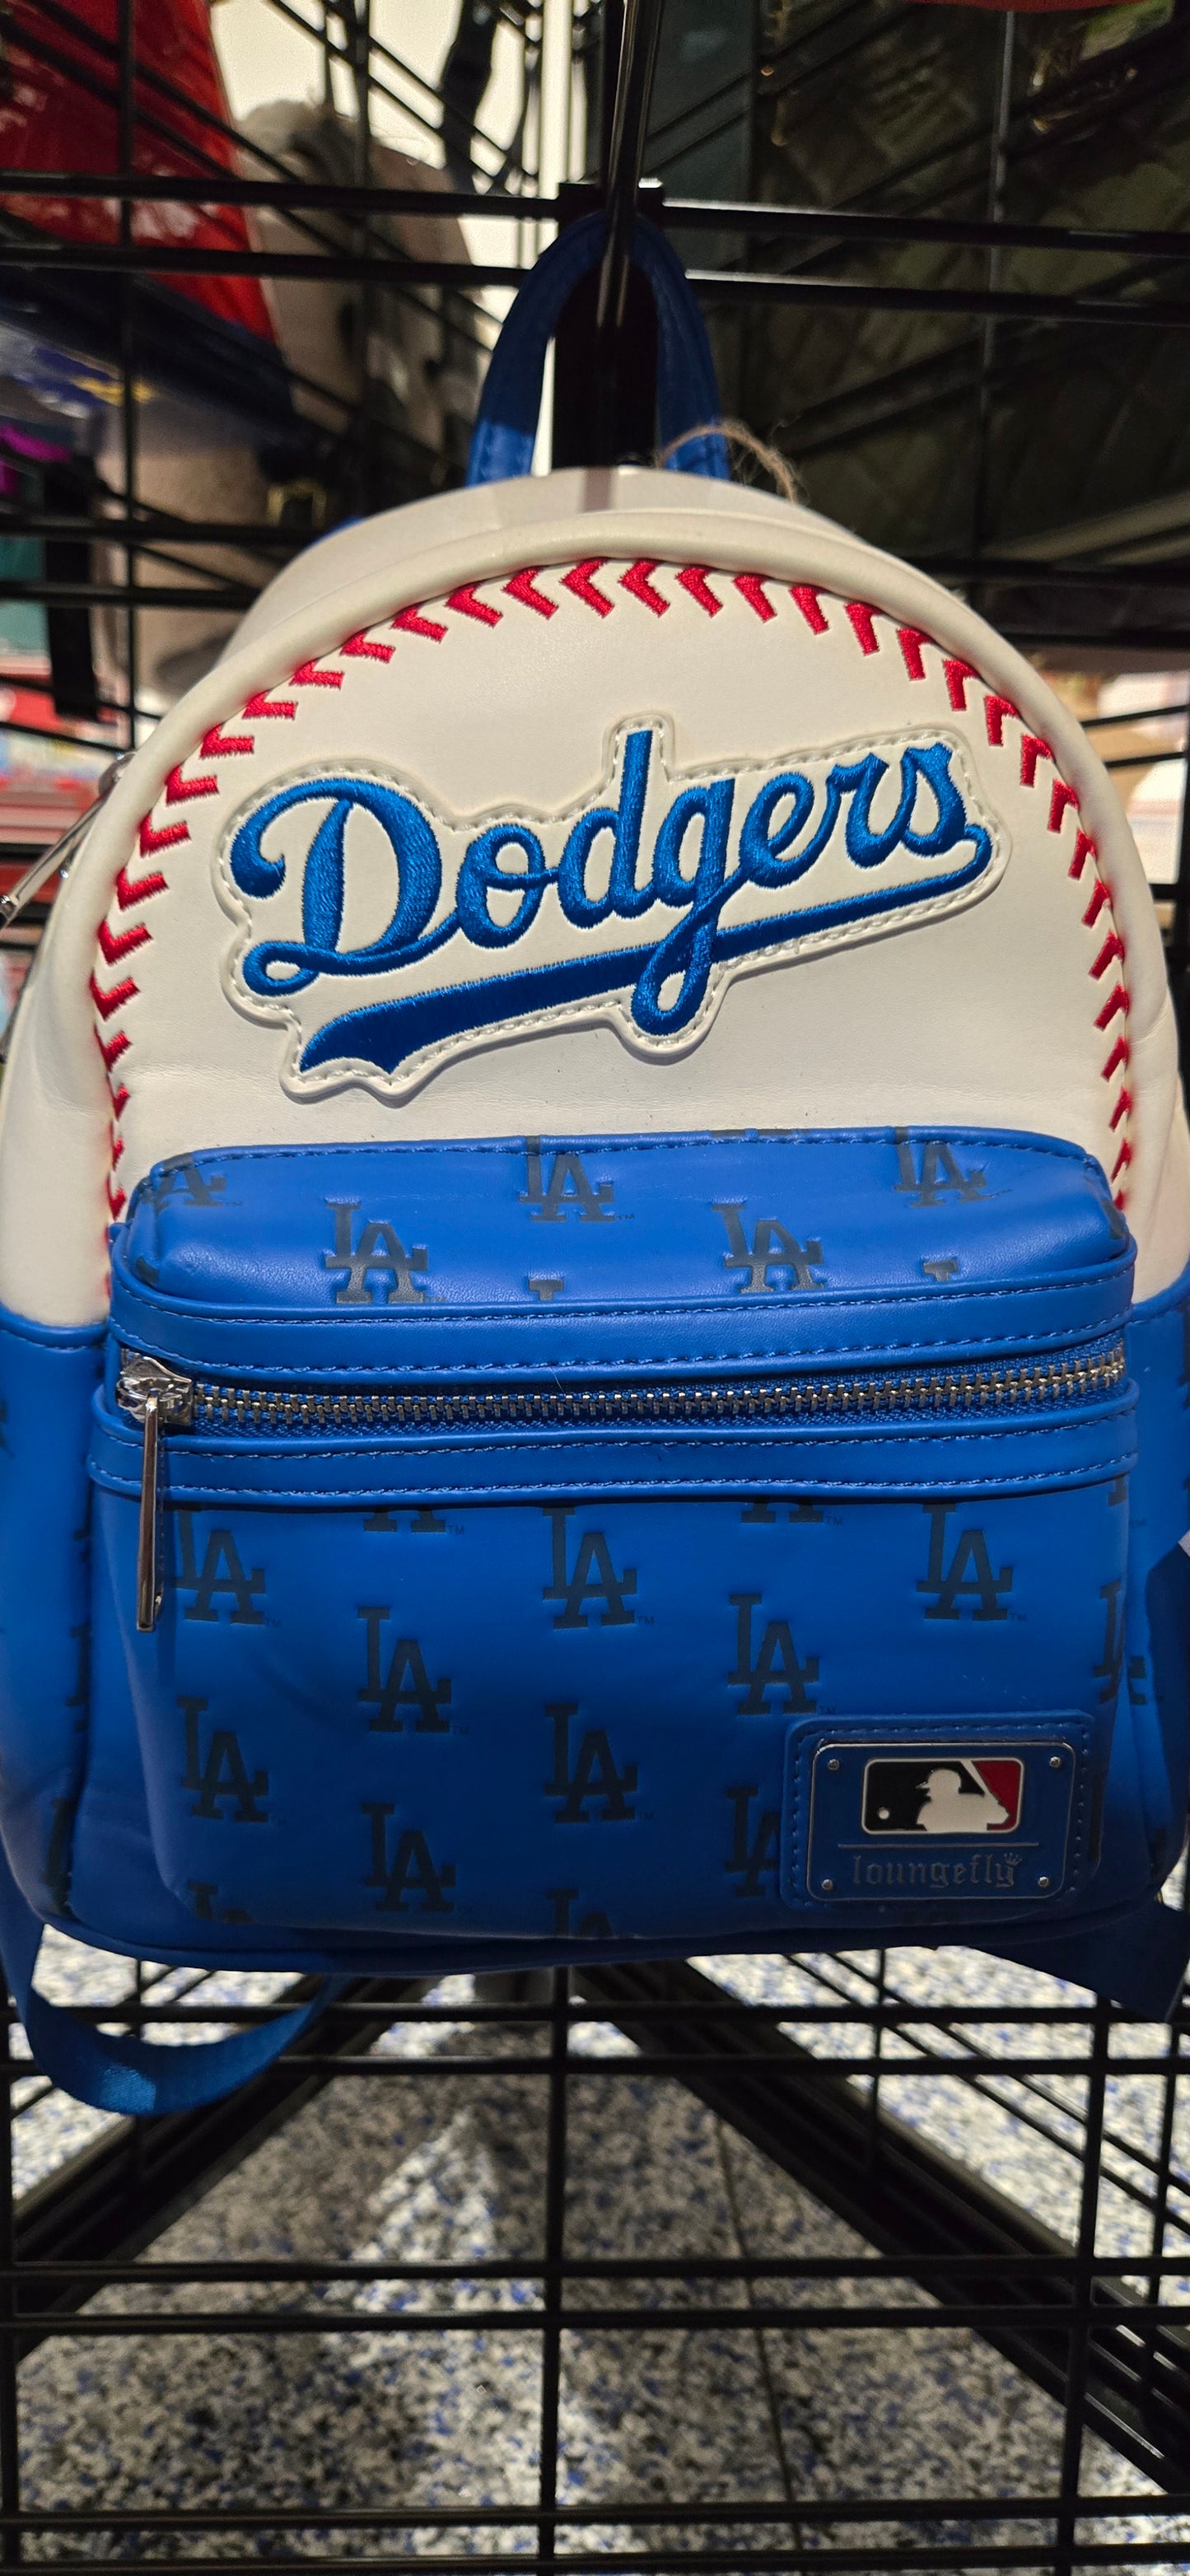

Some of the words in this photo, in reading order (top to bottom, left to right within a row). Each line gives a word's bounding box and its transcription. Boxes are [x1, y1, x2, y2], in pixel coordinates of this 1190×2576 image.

[231, 730, 991, 1036] Dodgers
[519, 1136, 614, 1221] LA
[324, 1204, 427, 1304] LA
[712, 1204, 824, 1293] LA
[173, 1510, 265, 1624] LA
[543, 1508, 637, 1629] LA
[917, 1503, 1013, 1621] LA
[357, 1607, 451, 1732] LA
[728, 1594, 819, 1715] LA
[176, 1696, 268, 1822] LA
[544, 1702, 638, 1823] LA
[362, 1803, 456, 1911] LA
[852, 1854, 1015, 1888] loungefly
